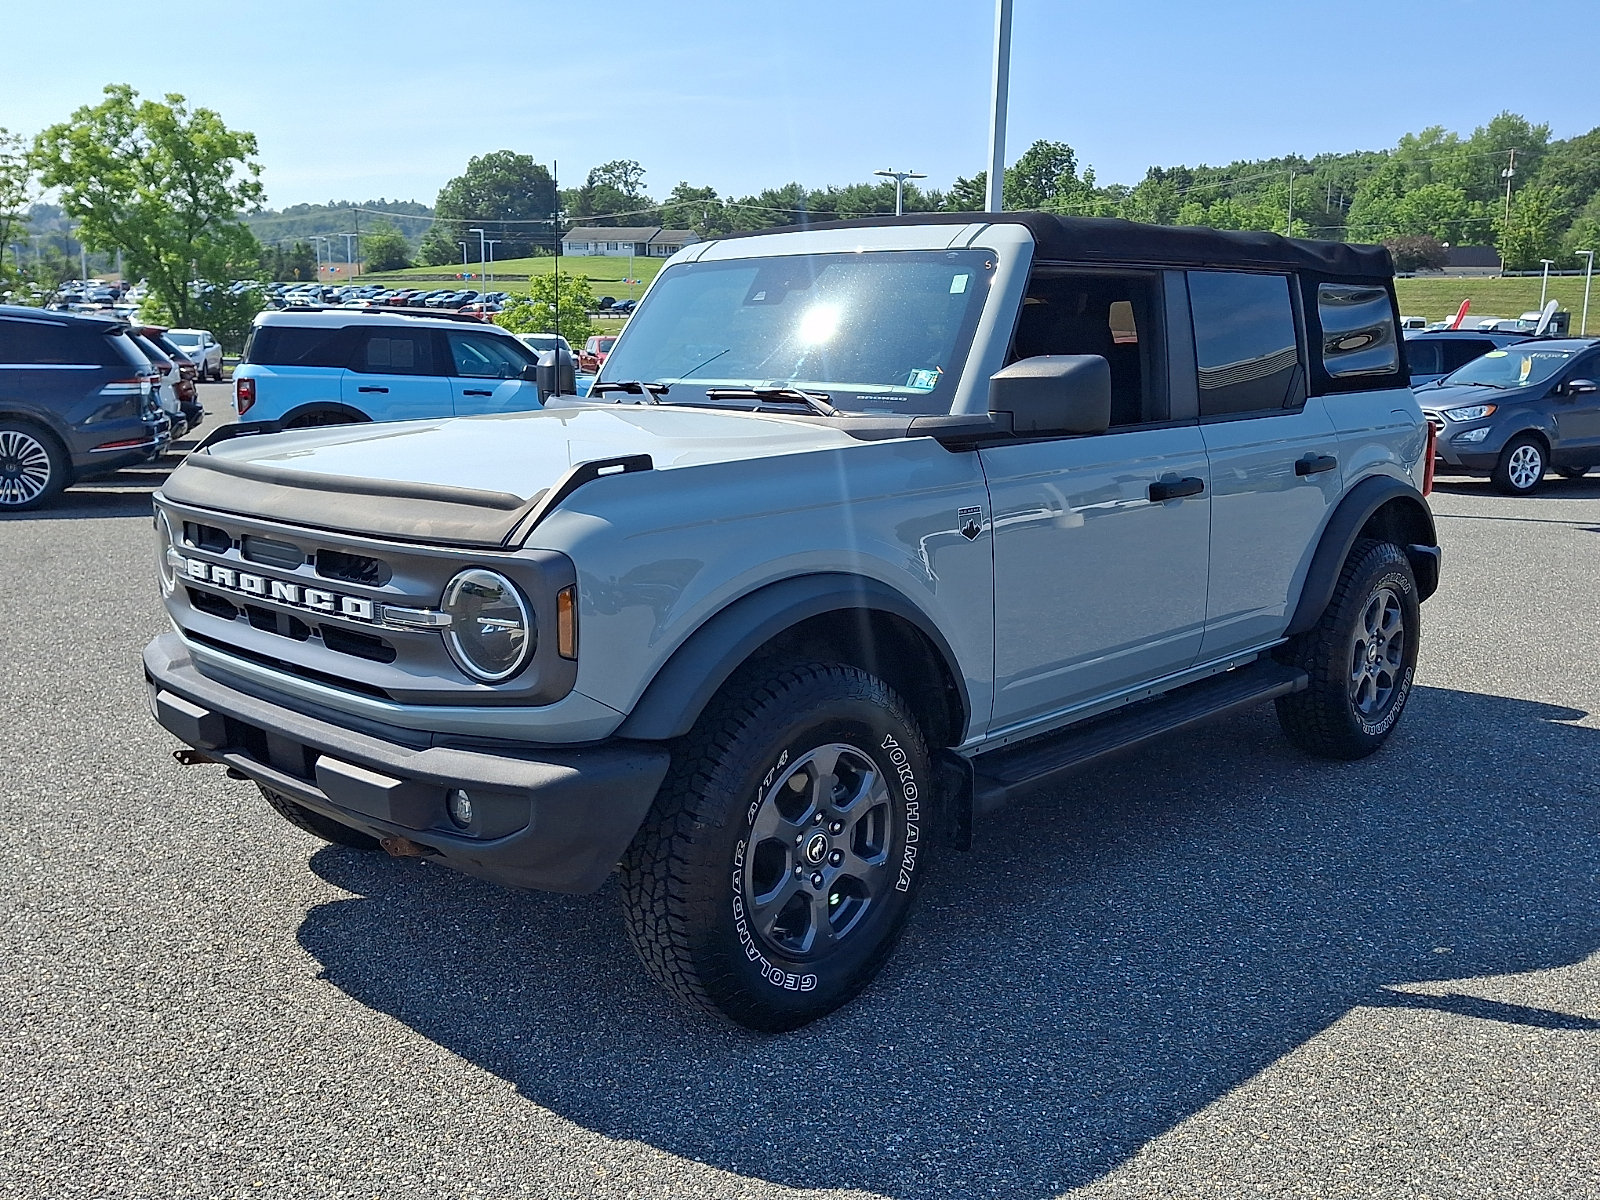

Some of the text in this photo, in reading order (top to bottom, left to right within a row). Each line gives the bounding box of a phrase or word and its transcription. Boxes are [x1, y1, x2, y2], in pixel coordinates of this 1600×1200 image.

[187, 557, 375, 621] BRONCO
[880, 733, 920, 892] YOKOHAMA
[732, 839, 818, 992] GEOLANDAR
